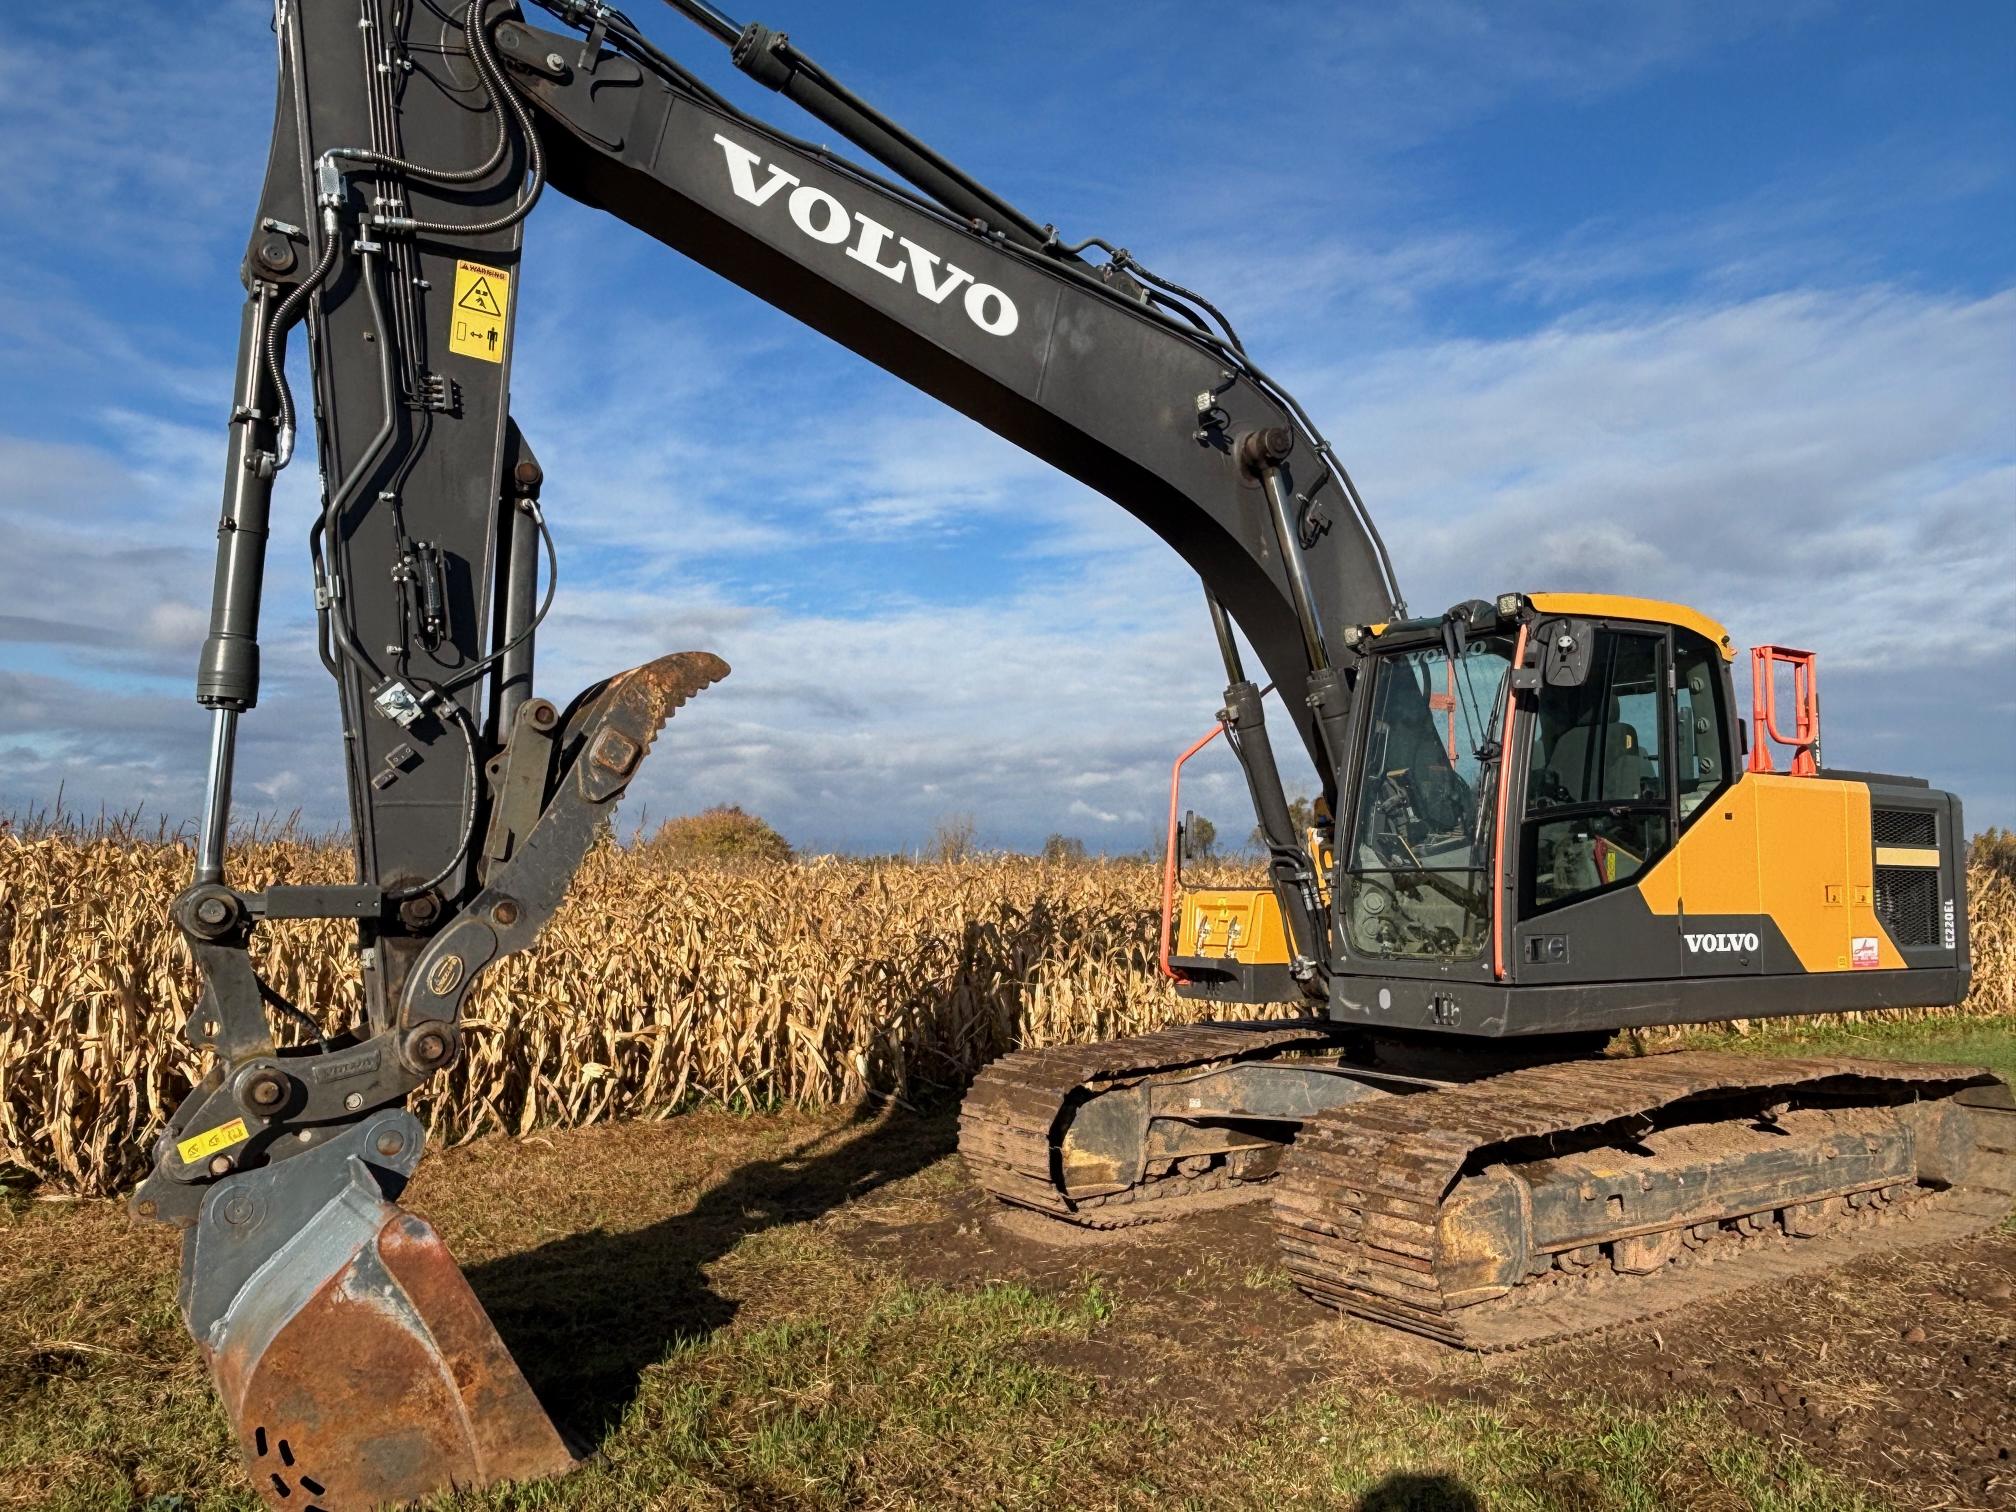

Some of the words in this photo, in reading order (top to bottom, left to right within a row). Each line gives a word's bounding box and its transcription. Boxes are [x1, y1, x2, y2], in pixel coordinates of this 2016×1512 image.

[713, 133, 1019, 336] VOLVO
[469, 264, 505, 280] WARNING
[1405, 640, 1487, 666] VOLO
[1944, 899, 1955, 949] EC220EL
[1683, 933, 1759, 953] VOLVO
